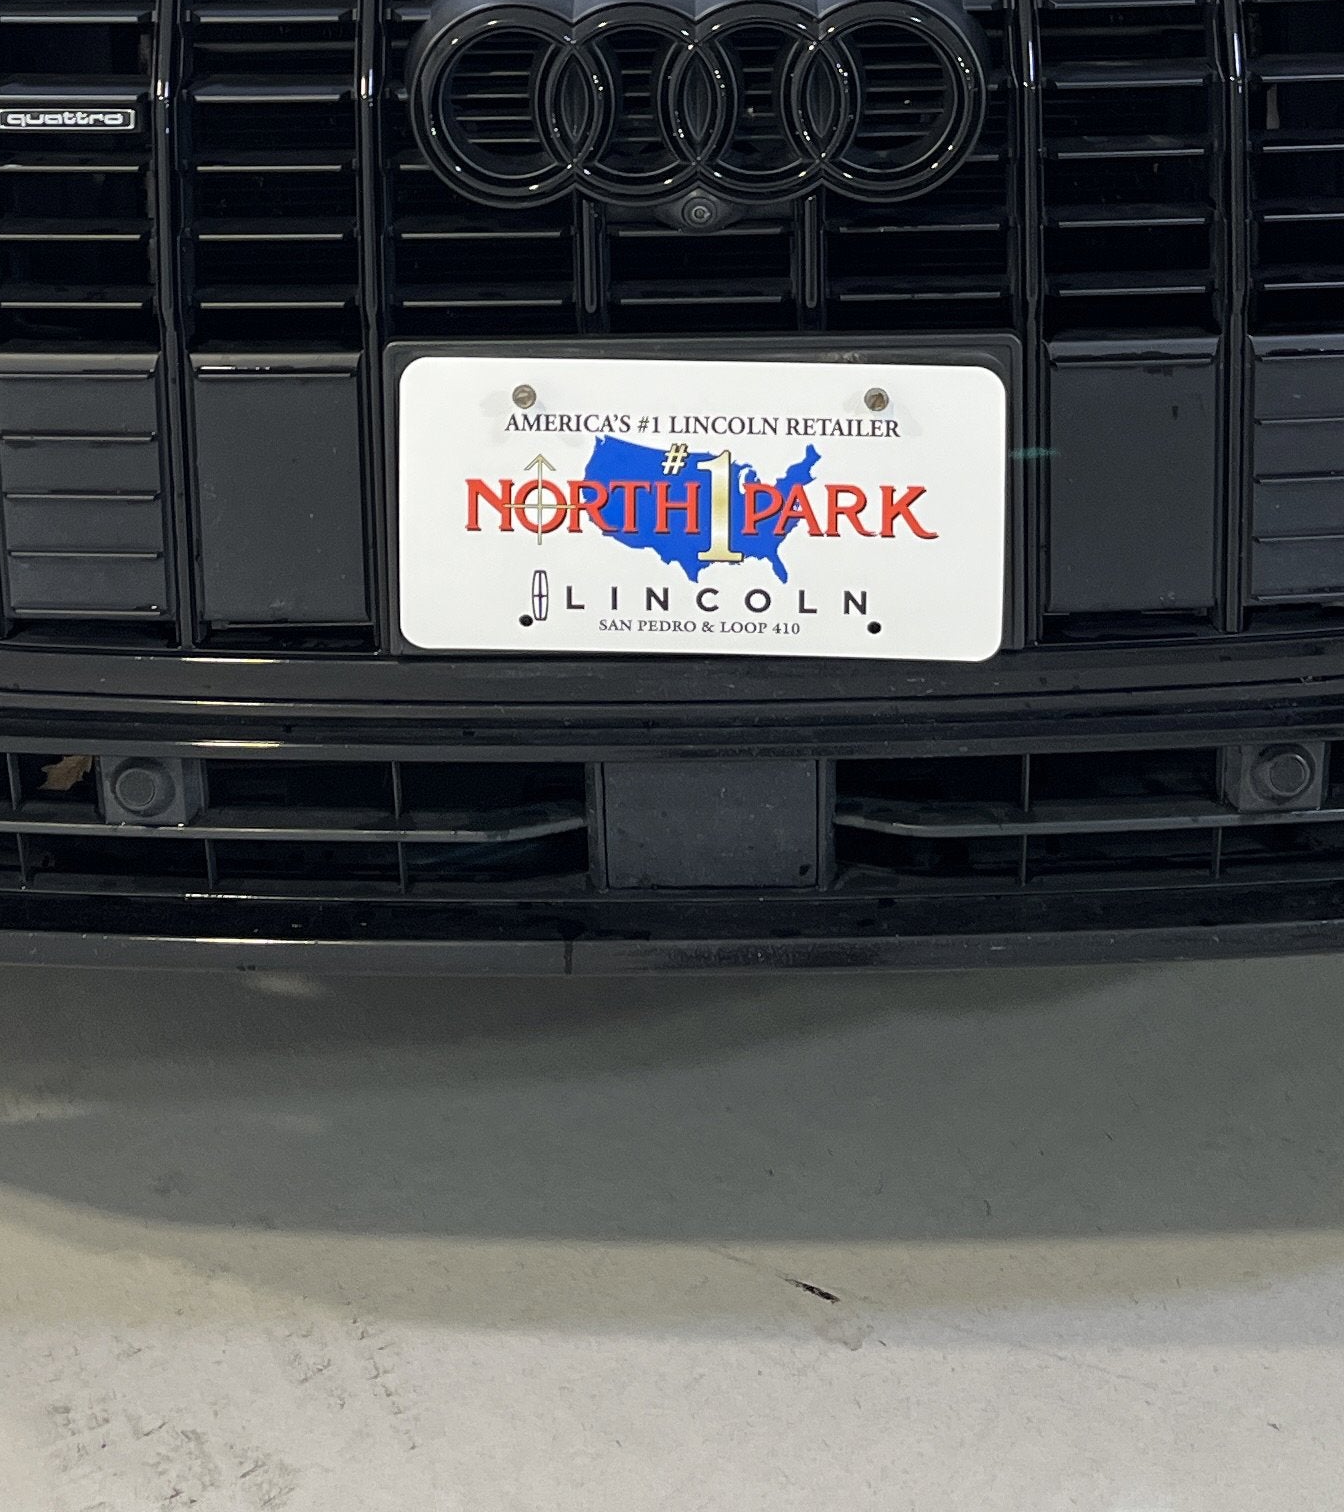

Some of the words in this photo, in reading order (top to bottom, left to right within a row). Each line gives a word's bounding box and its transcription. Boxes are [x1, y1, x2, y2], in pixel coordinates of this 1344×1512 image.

[6, 111, 124, 128] quattro
[504, 413, 632, 434] AMERICA'S
[637, 415, 660, 435] #1
[668, 415, 779, 437] LINCOLN
[785, 417, 901, 439] RETAILER
[465, 478, 700, 535] NORTH
[741, 483, 939, 540] PARK
[566, 585, 867, 616] LINCOLN
[598, 619, 632, 632] SAN
[637, 619, 697, 634] PEDRO
[701, 620, 715, 634] &
[720, 621, 768, 635] LOOP
[772, 622, 801, 636] 410
